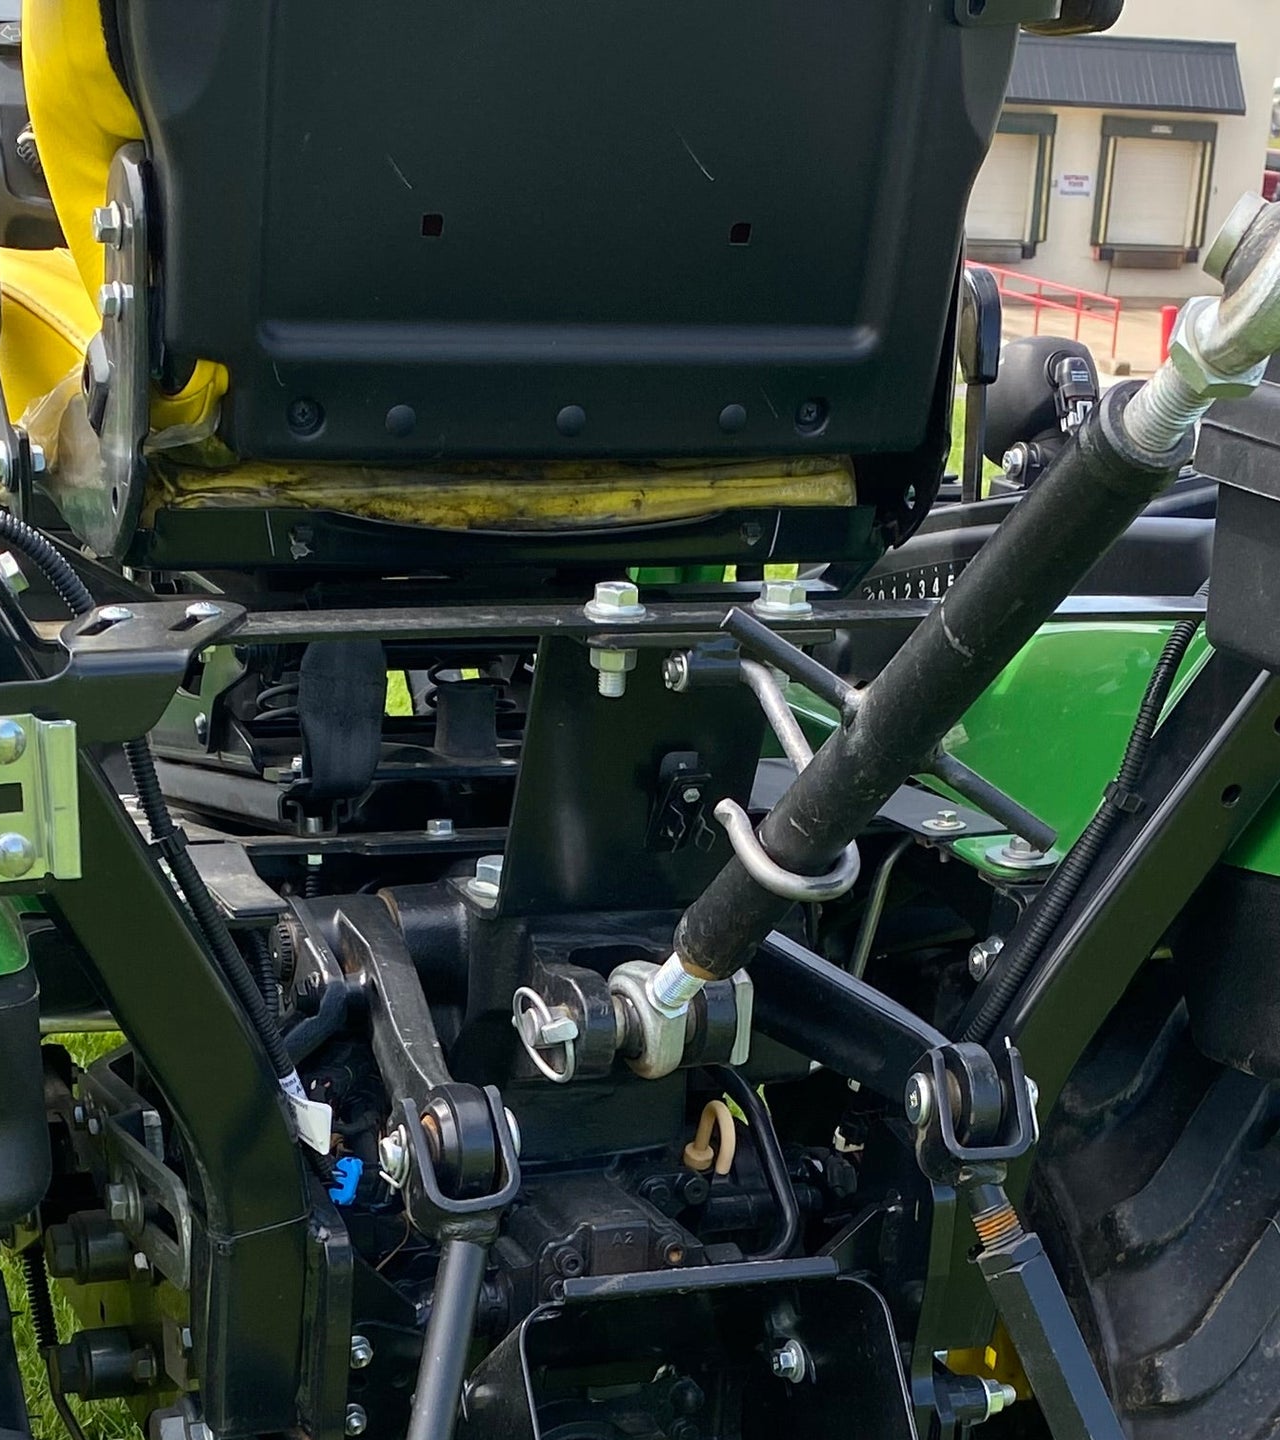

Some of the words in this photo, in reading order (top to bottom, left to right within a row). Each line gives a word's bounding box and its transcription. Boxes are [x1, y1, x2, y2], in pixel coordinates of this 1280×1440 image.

[904, 582, 912, 600] 2
[918, 579, 926, 599] 3
[932, 576, 939, 597] 4
[611, 1231, 634, 1245] A2
